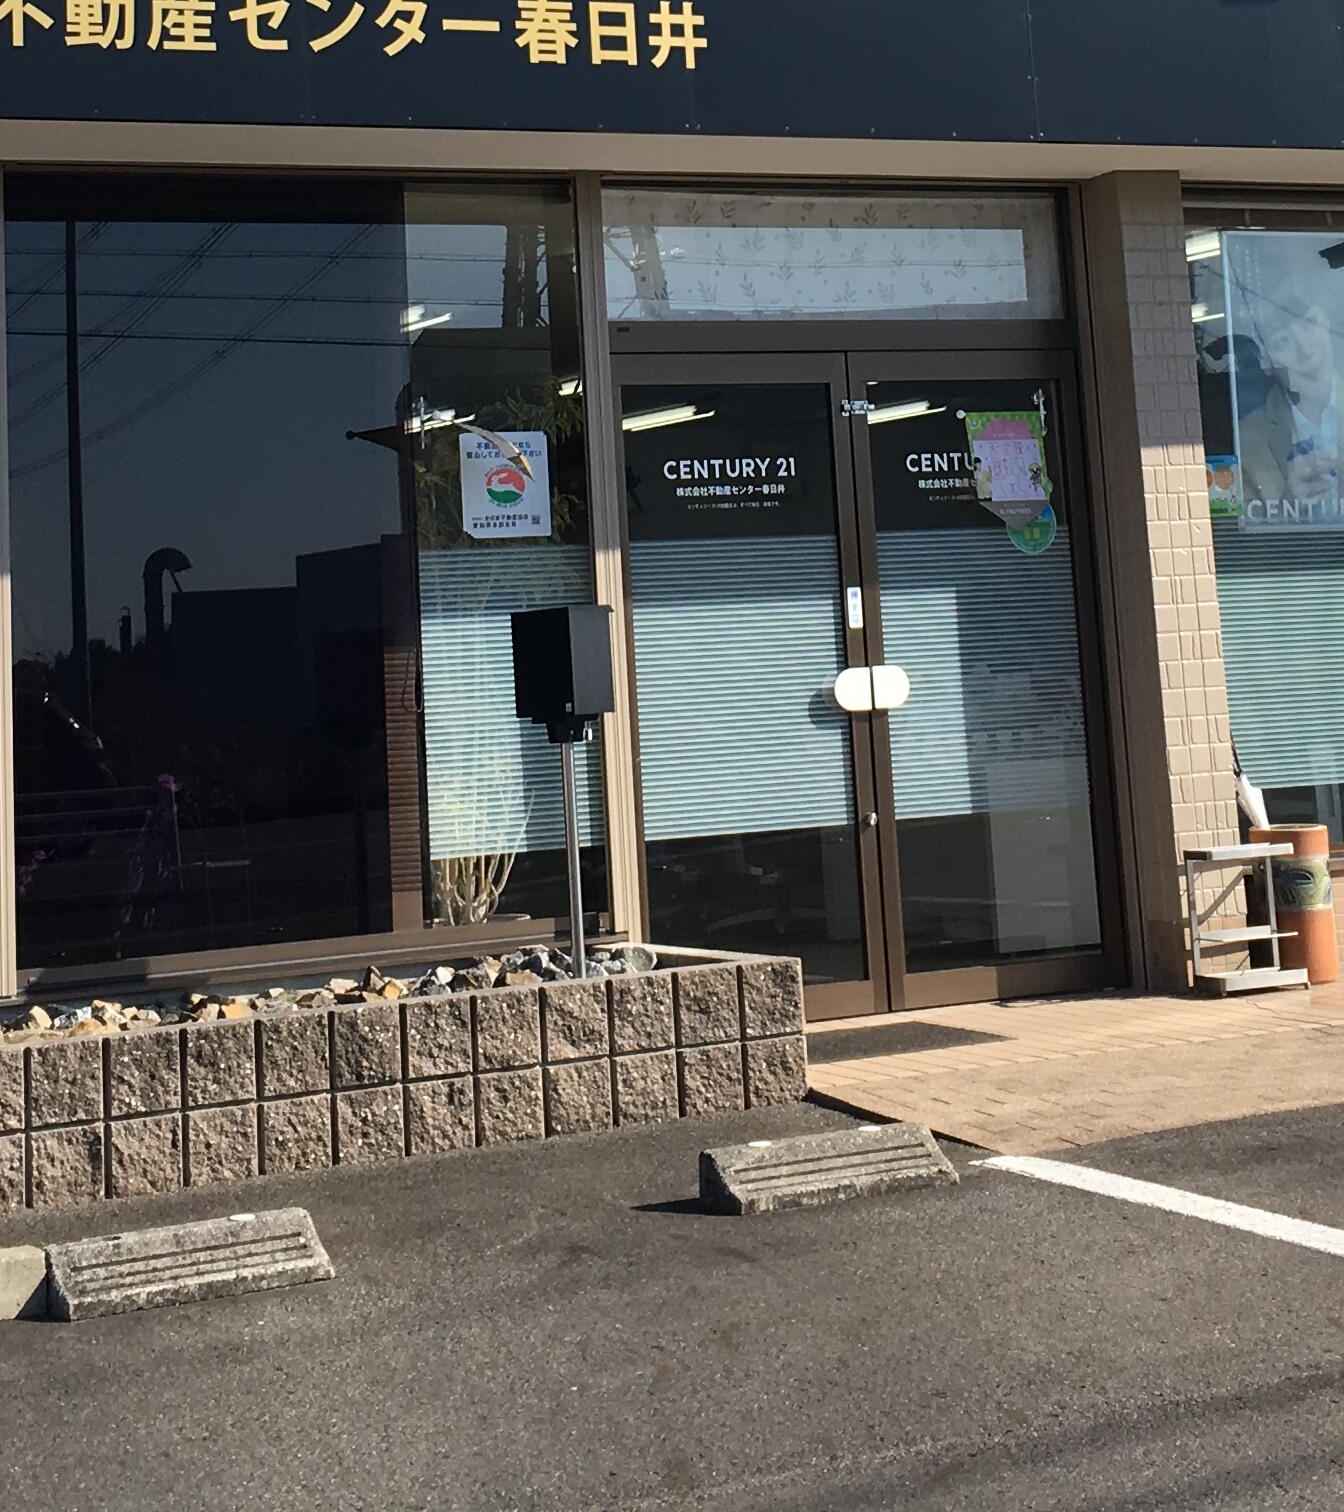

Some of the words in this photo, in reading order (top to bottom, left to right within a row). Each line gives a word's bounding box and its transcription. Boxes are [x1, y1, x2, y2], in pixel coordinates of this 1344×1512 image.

[663, 457, 770, 480] CENTURY
[776, 457, 796, 477] 21
[906, 452, 975, 473] CENTU
